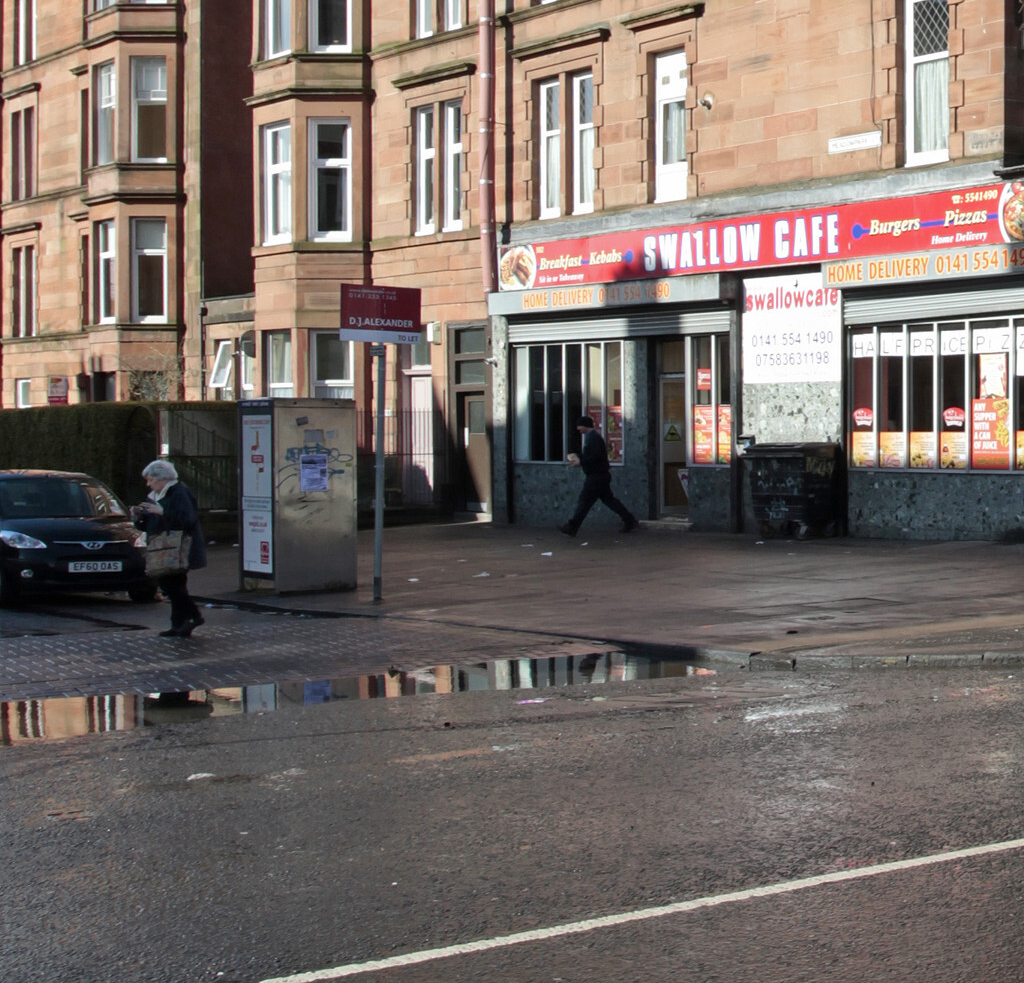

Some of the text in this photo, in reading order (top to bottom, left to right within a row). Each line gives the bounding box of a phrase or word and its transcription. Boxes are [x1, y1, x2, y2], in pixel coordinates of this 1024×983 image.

[964, 189, 998, 204] 5541490
[868, 208, 988, 237] Burgers Pizzas
[643, 213, 839, 272] SWALLOW CAFE
[931, 231, 988, 245] Home Delivery
[539, 249, 623, 270] Breakfast Kebabs
[828, 263, 863, 284] HOME
[868, 257, 929, 279] DELIVERY
[936, 253, 968, 274] 0141
[973, 249, 999, 271] 554
[522, 281, 670, 310] HOME DELIVERY 0141 554 1490
[752, 331, 833, 347] 0141 554 1490
[974, 403, 987, 412] ANY
[974, 412, 997, 421] SUPPER
[974, 422, 990, 431] WITH
[974, 431, 991, 440] A CAN
[974, 440, 998, 450] OF JUICE
[73, 562, 119, 571] EF60 OAS
